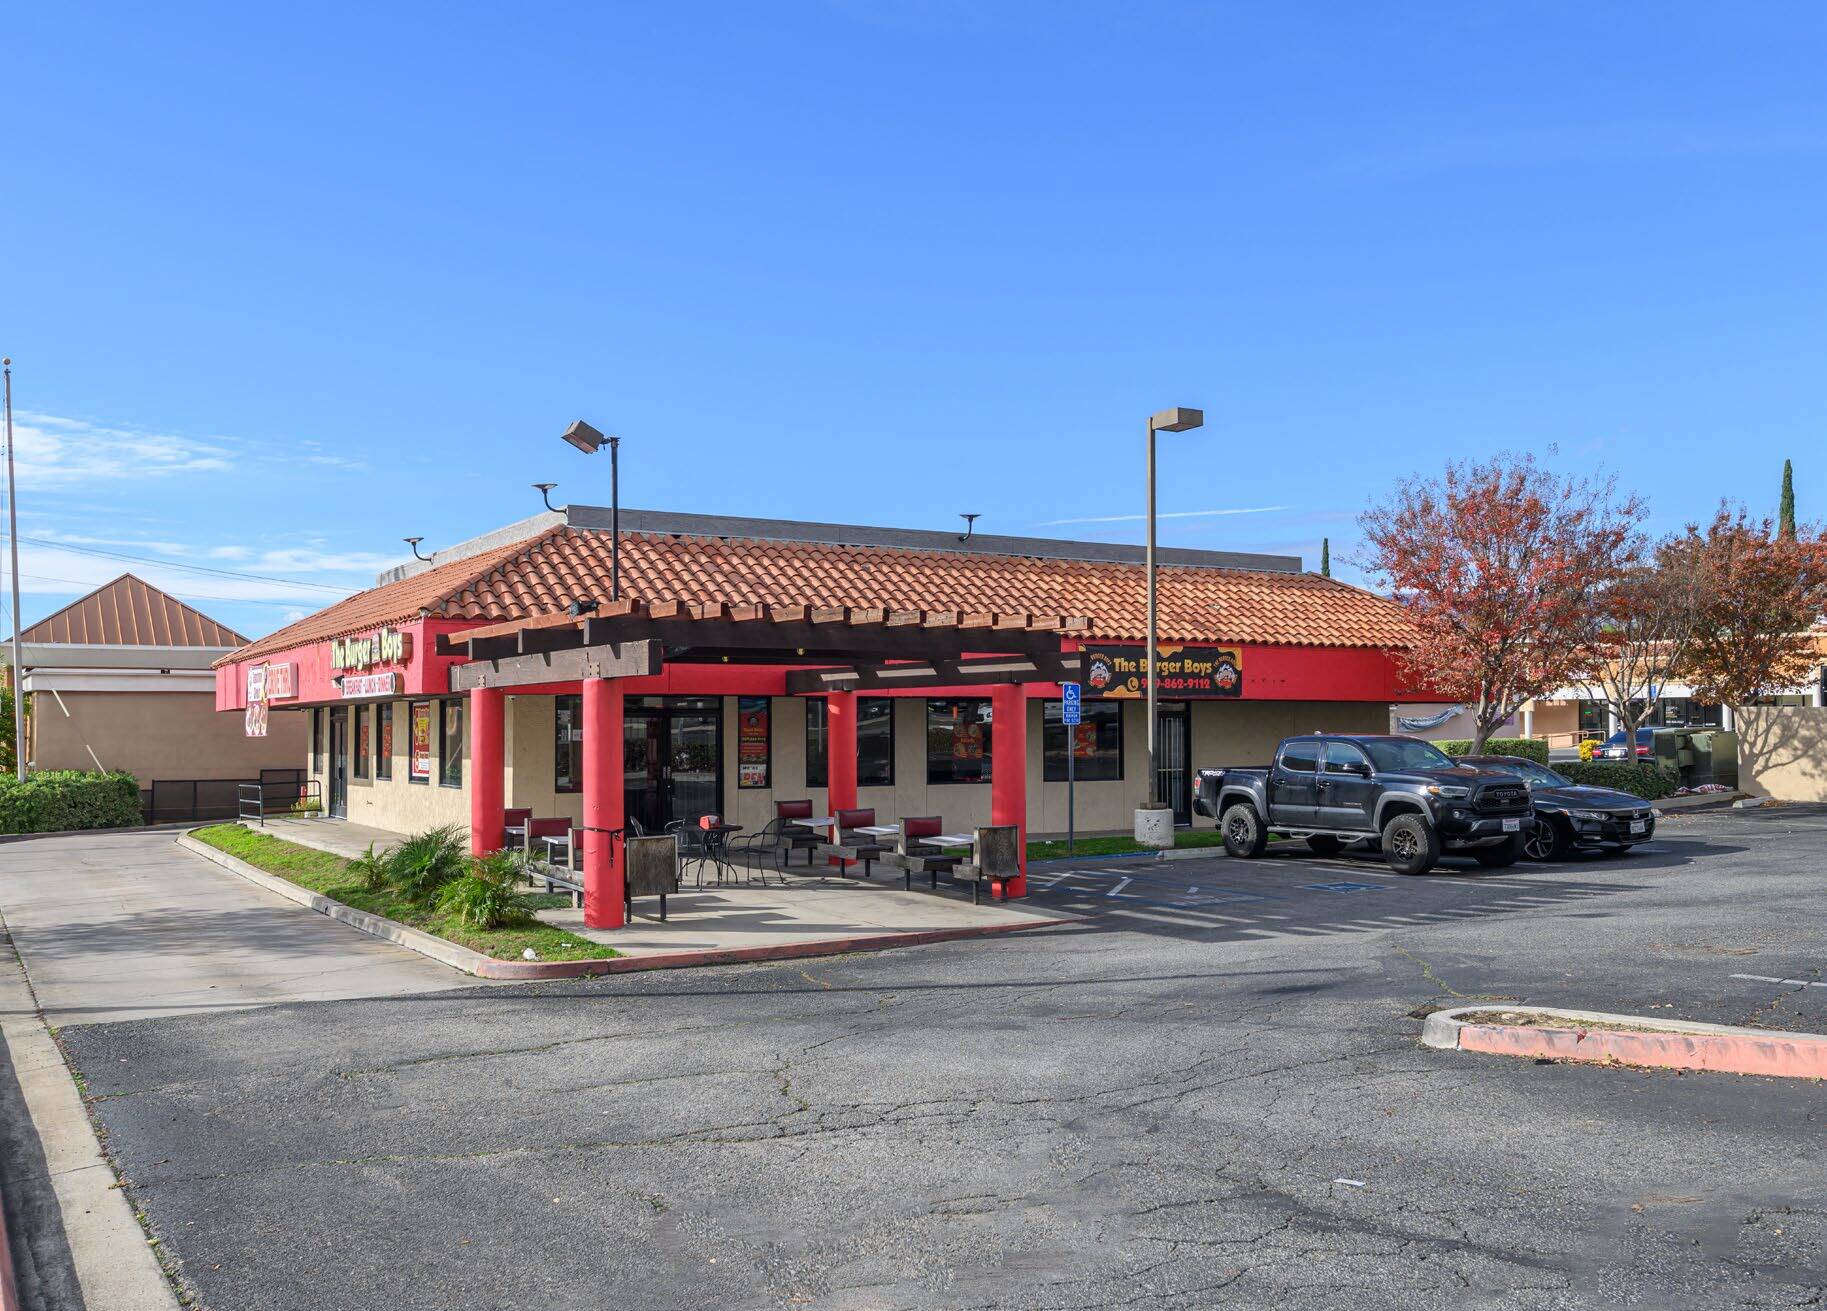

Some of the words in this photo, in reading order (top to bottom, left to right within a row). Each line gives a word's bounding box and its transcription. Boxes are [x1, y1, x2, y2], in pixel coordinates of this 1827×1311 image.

[332, 640, 345, 669] The
[345, 638, 371, 671] Burger
[381, 627, 403, 664] Boys
[1113, 657, 1137, 672] The
[1140, 658, 1181, 676] Brger
[1184, 658, 1212, 676] Boys
[1141, 677, 1211, 689] 99-862-9112
